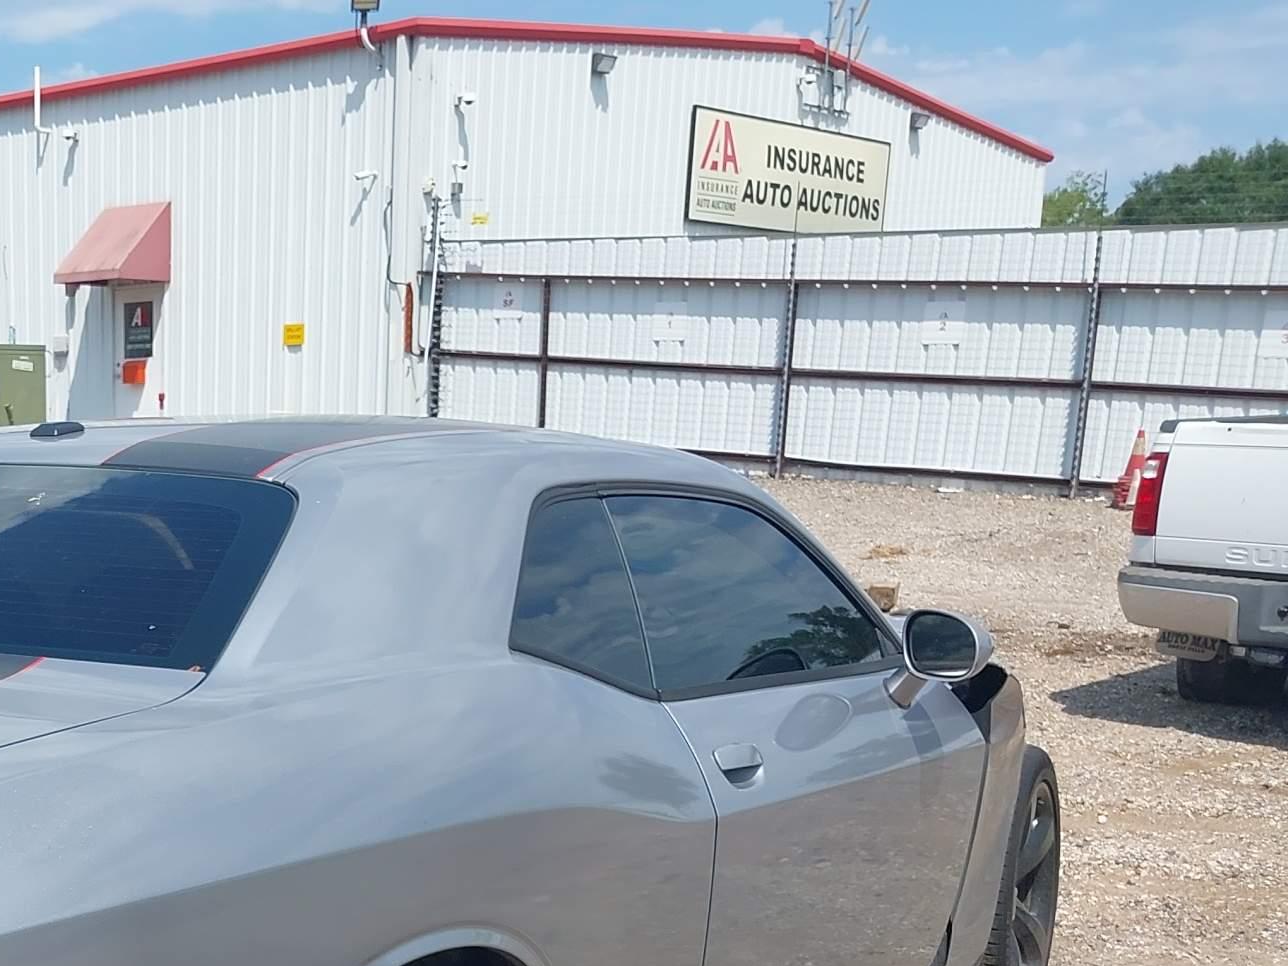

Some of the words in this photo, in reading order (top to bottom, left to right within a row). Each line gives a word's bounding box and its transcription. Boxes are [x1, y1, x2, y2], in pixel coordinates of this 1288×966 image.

[766, 144, 866, 184] INSURANCE
[697, 180, 739, 195] INSURANCE
[741, 179, 793, 209] AUTO
[797, 187, 881, 222] AUCTIONS
[1159, 631, 1190, 645] AUTO
[1191, 634, 1218, 652] MAX
